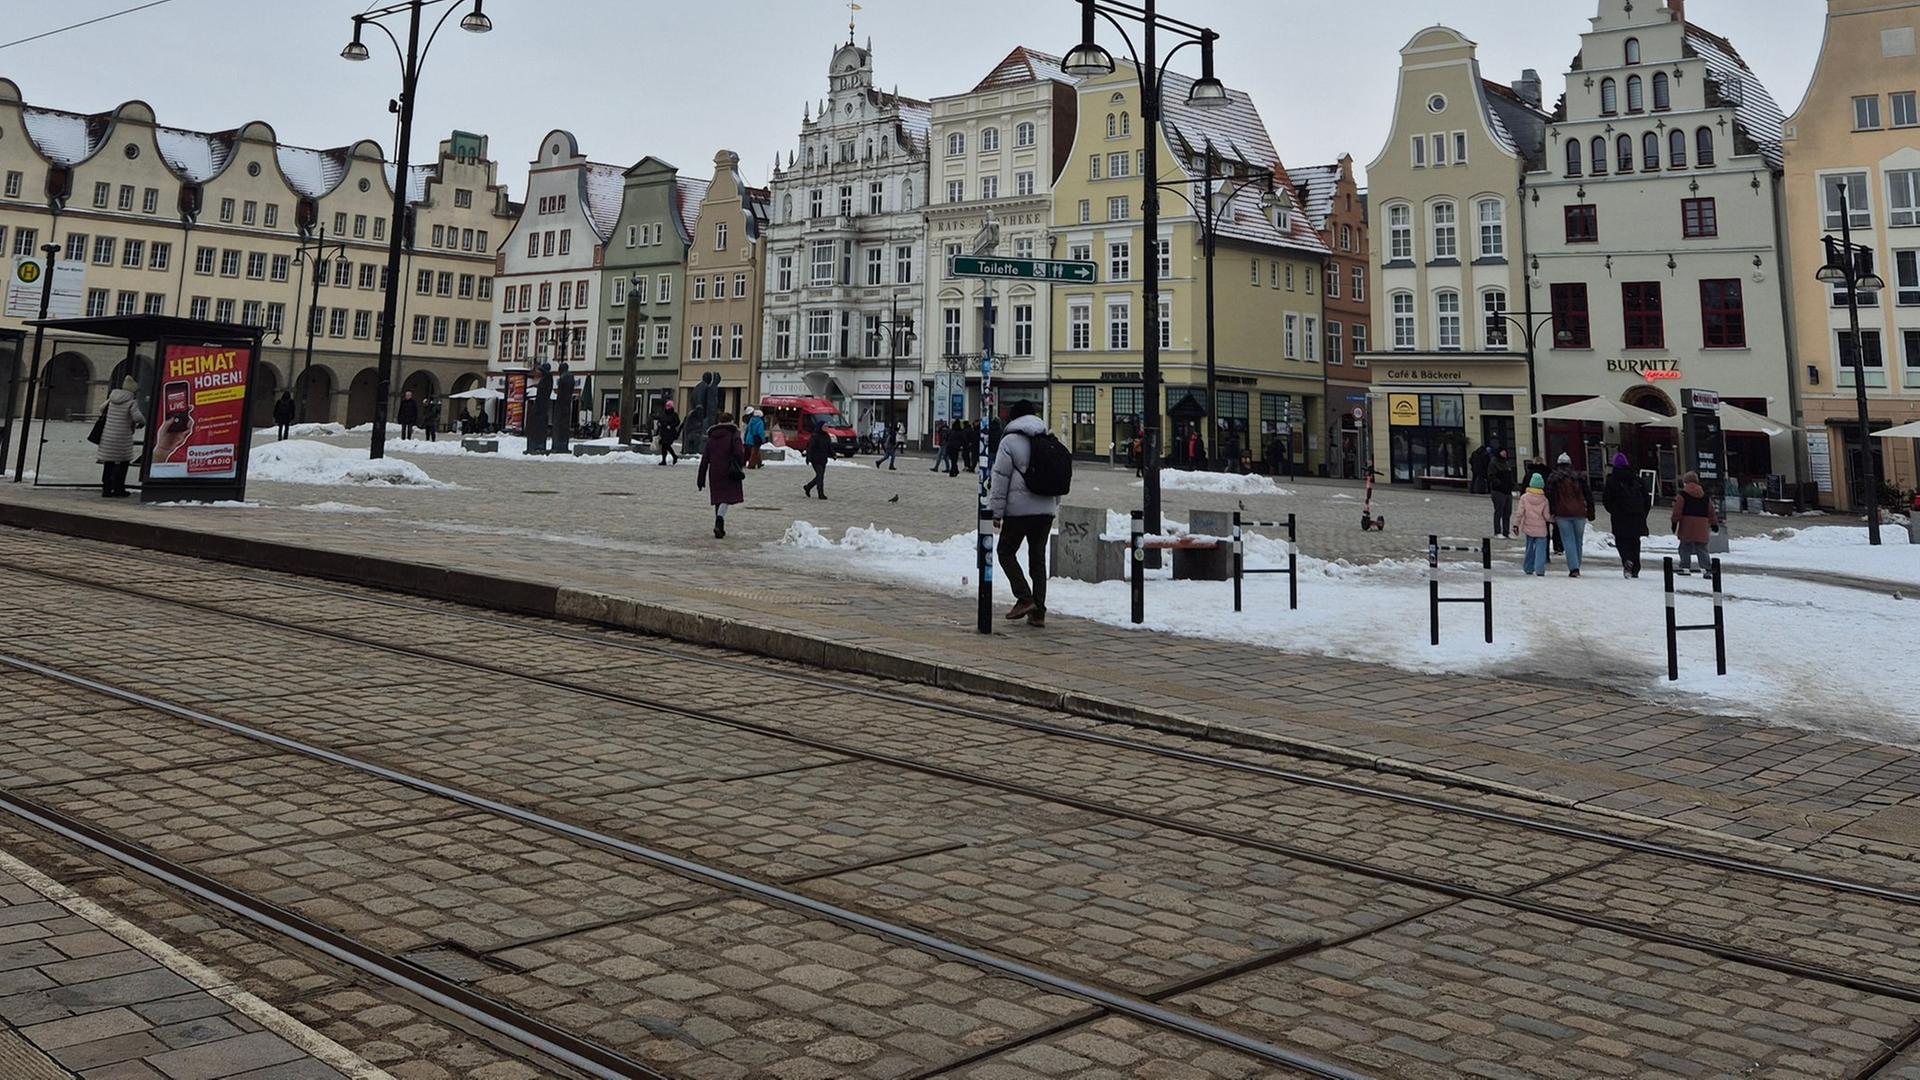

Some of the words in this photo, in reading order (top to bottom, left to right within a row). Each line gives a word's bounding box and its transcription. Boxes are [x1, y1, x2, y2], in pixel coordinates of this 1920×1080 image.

[938, 220, 965, 232] RATS
[978, 213, 1041, 229] AOTHEKE
[23, 264, 35, 280] H
[978, 261, 1019, 275] Toilette
[169, 351, 237, 377] HEIMAT
[1606, 359, 1680, 377] BURWITZ
[194, 370, 243, 389] HÖREN!
[1387, 370, 1409, 379] Café
[1411, 370, 1418, 379] &
[1420, 369, 1462, 380] Bäckerei
[207, 457, 231, 466] RADIO
